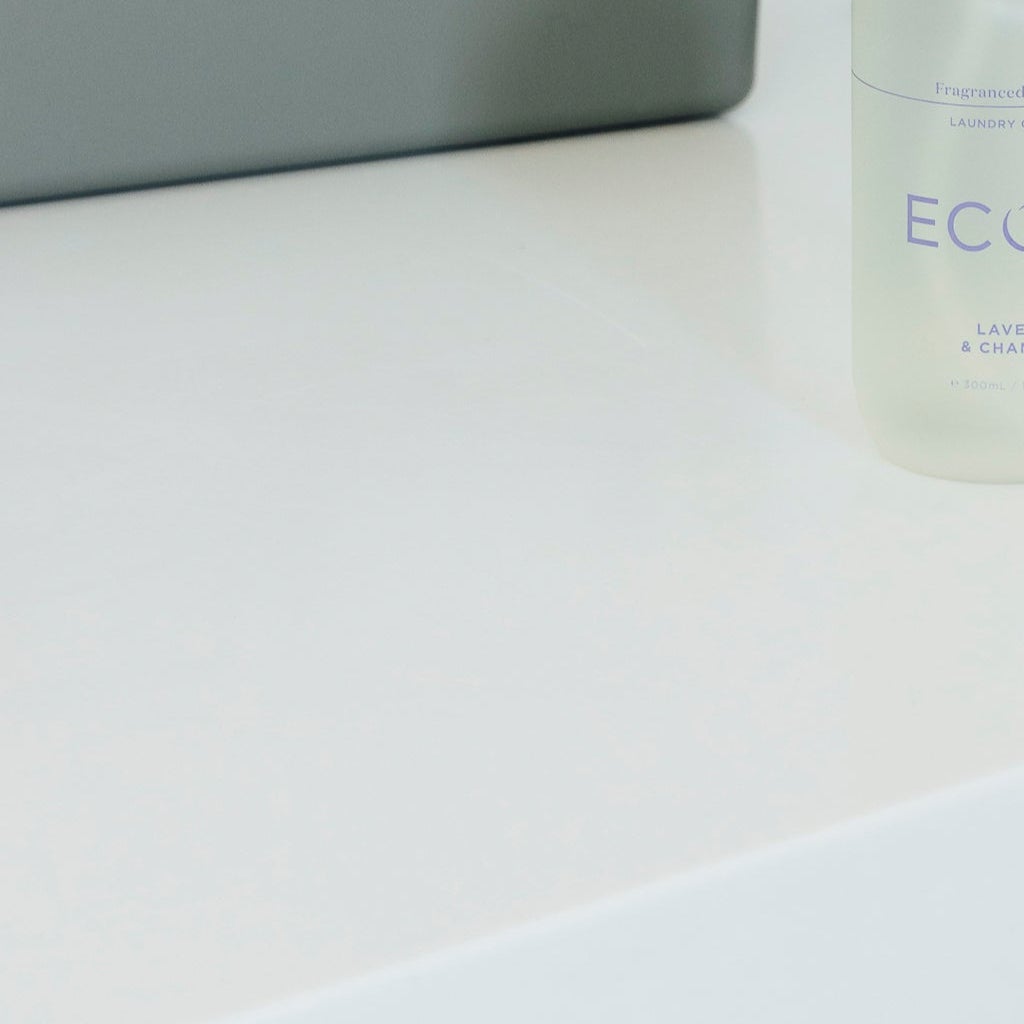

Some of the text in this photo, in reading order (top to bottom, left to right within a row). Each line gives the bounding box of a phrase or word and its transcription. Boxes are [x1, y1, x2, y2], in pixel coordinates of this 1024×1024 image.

[935, 81, 1024, 100] Fragranced
[950, 117, 1016, 129] LAUNDRY
[961, 340, 971, 353] &
